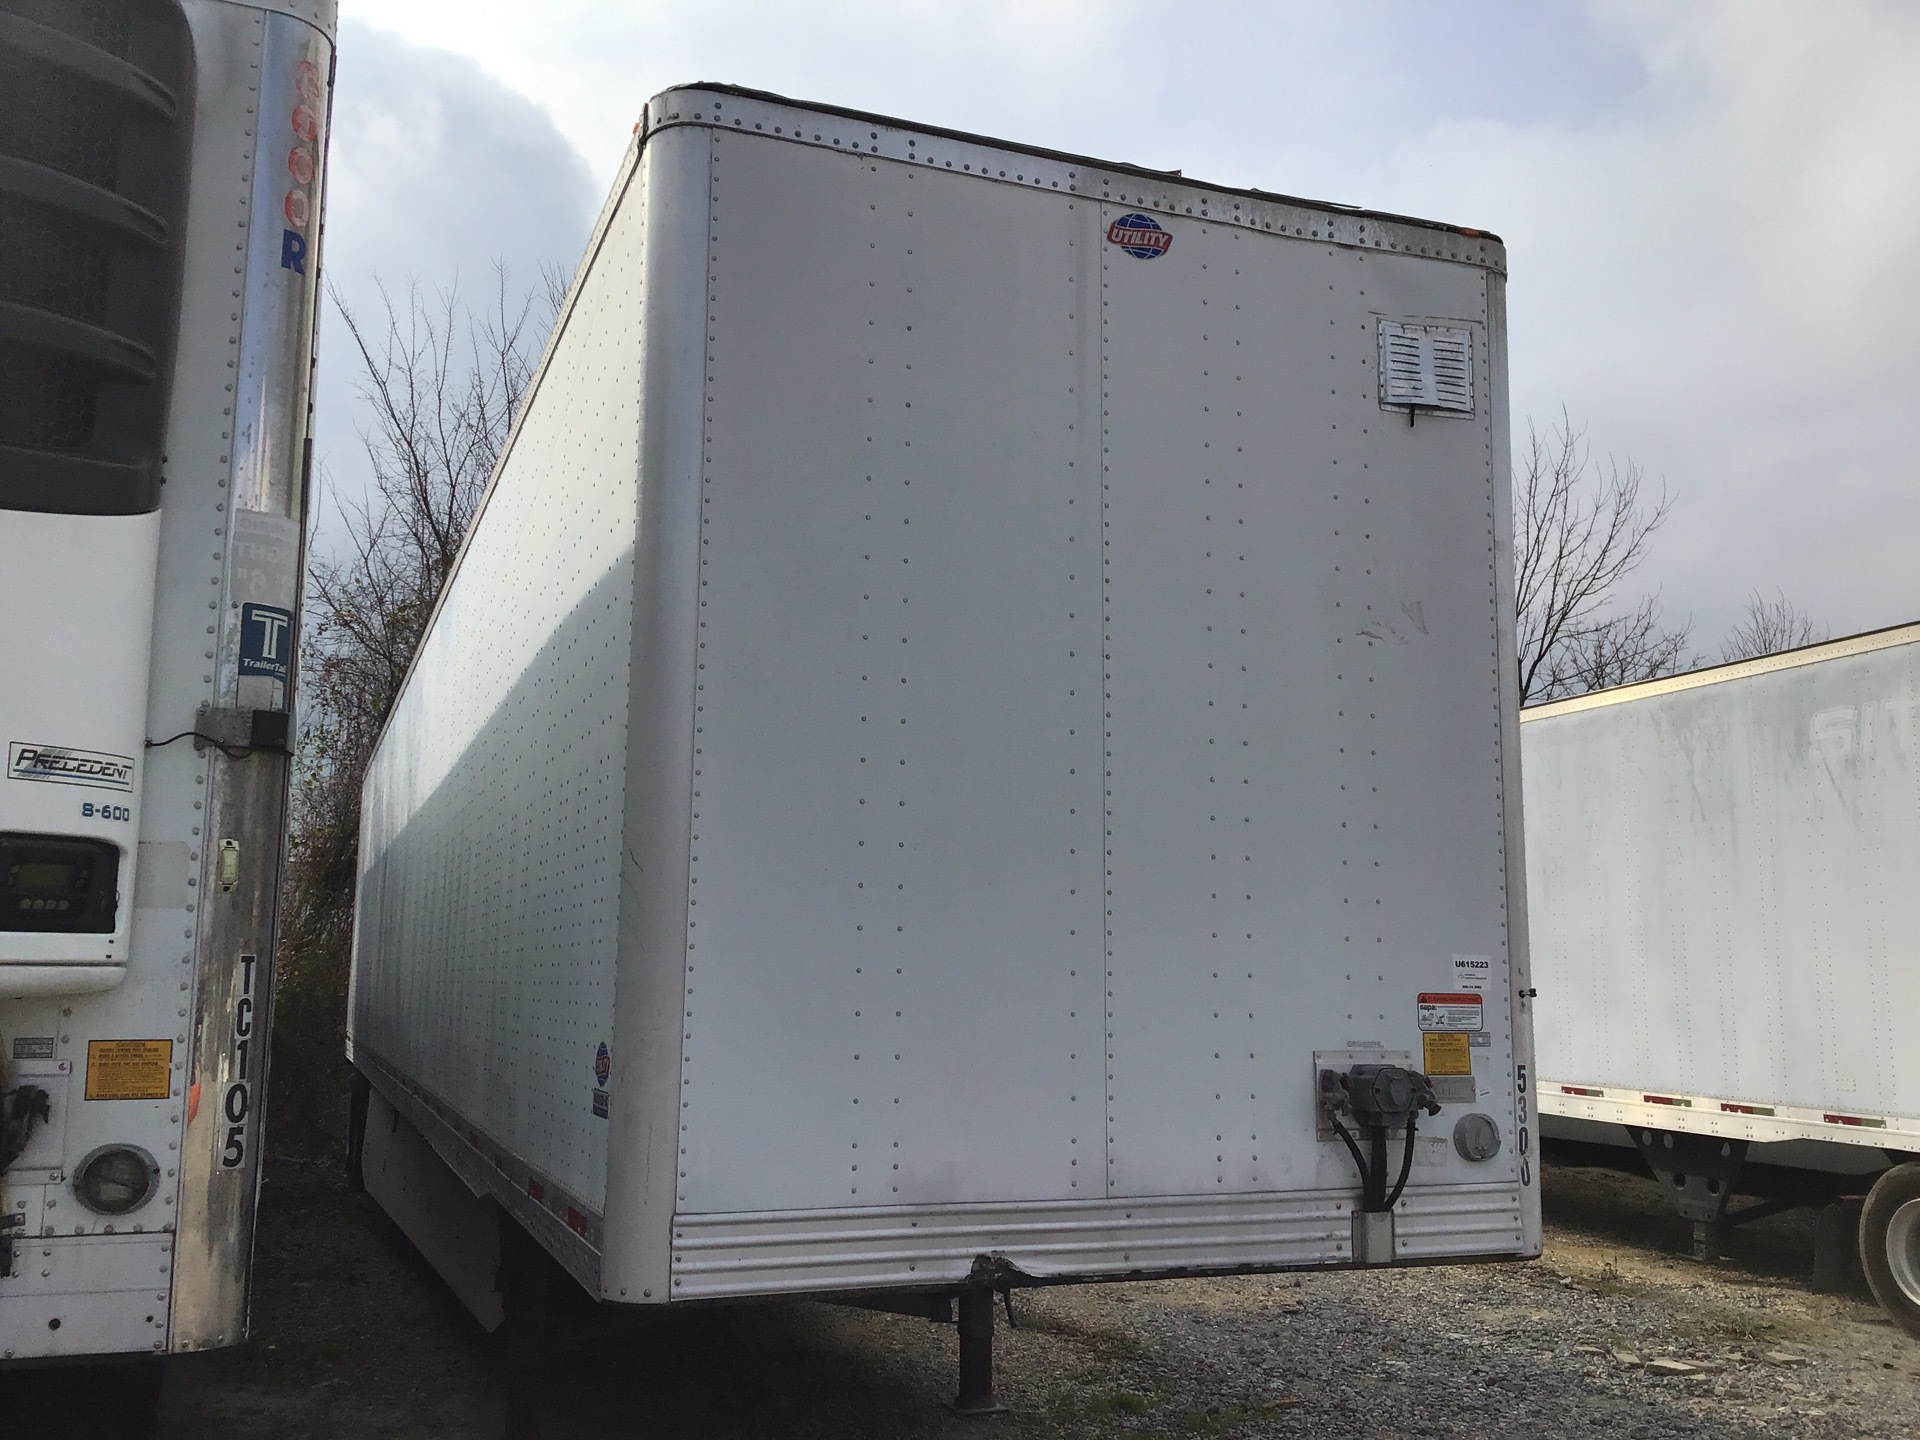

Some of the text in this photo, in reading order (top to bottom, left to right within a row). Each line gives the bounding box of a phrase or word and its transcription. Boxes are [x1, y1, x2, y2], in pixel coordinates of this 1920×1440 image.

[1110, 227, 1170, 248] UTILITY
[15, 748, 133, 780] PRECEDENT
[1455, 960, 1489, 969] U615223
[222, 955, 256, 1168] TC105
[1517, 1064, 1531, 1187] 5300
